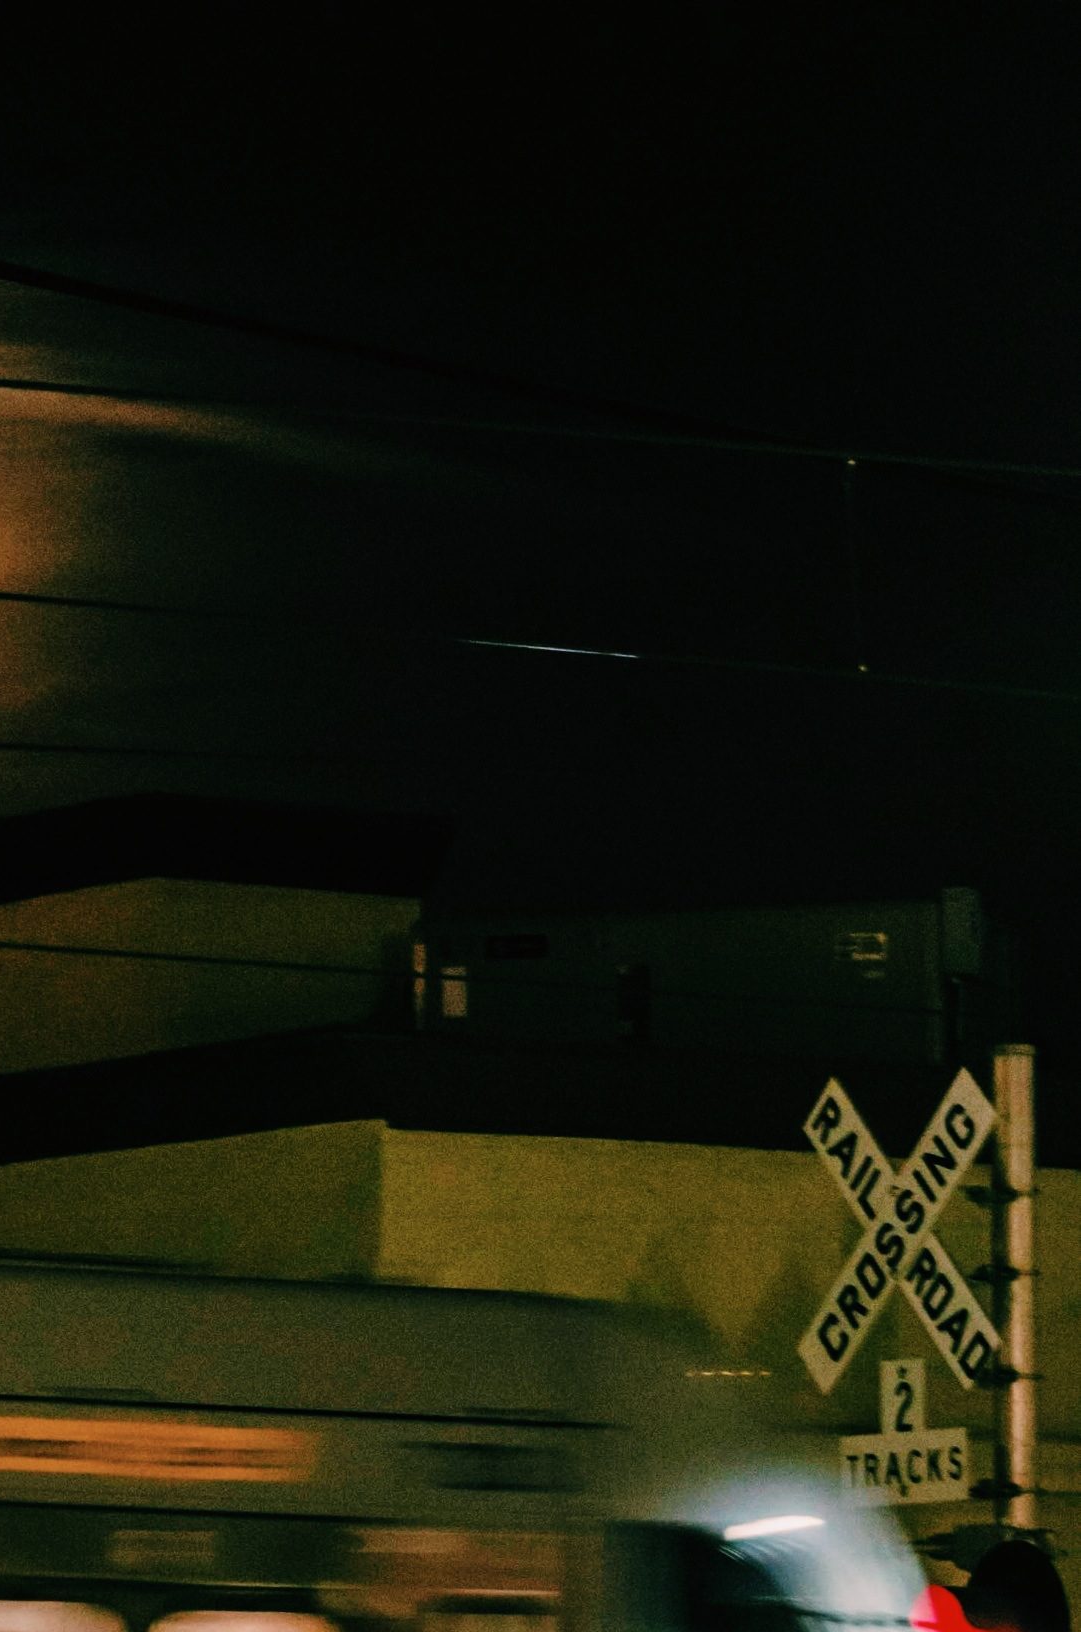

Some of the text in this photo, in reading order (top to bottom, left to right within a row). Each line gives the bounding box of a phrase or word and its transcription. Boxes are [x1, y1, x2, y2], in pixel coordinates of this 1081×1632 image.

[816, 1103, 976, 1363] CROSSING
[894, 1381, 914, 1432] 2
[845, 1446, 963, 1489] TRACKS
